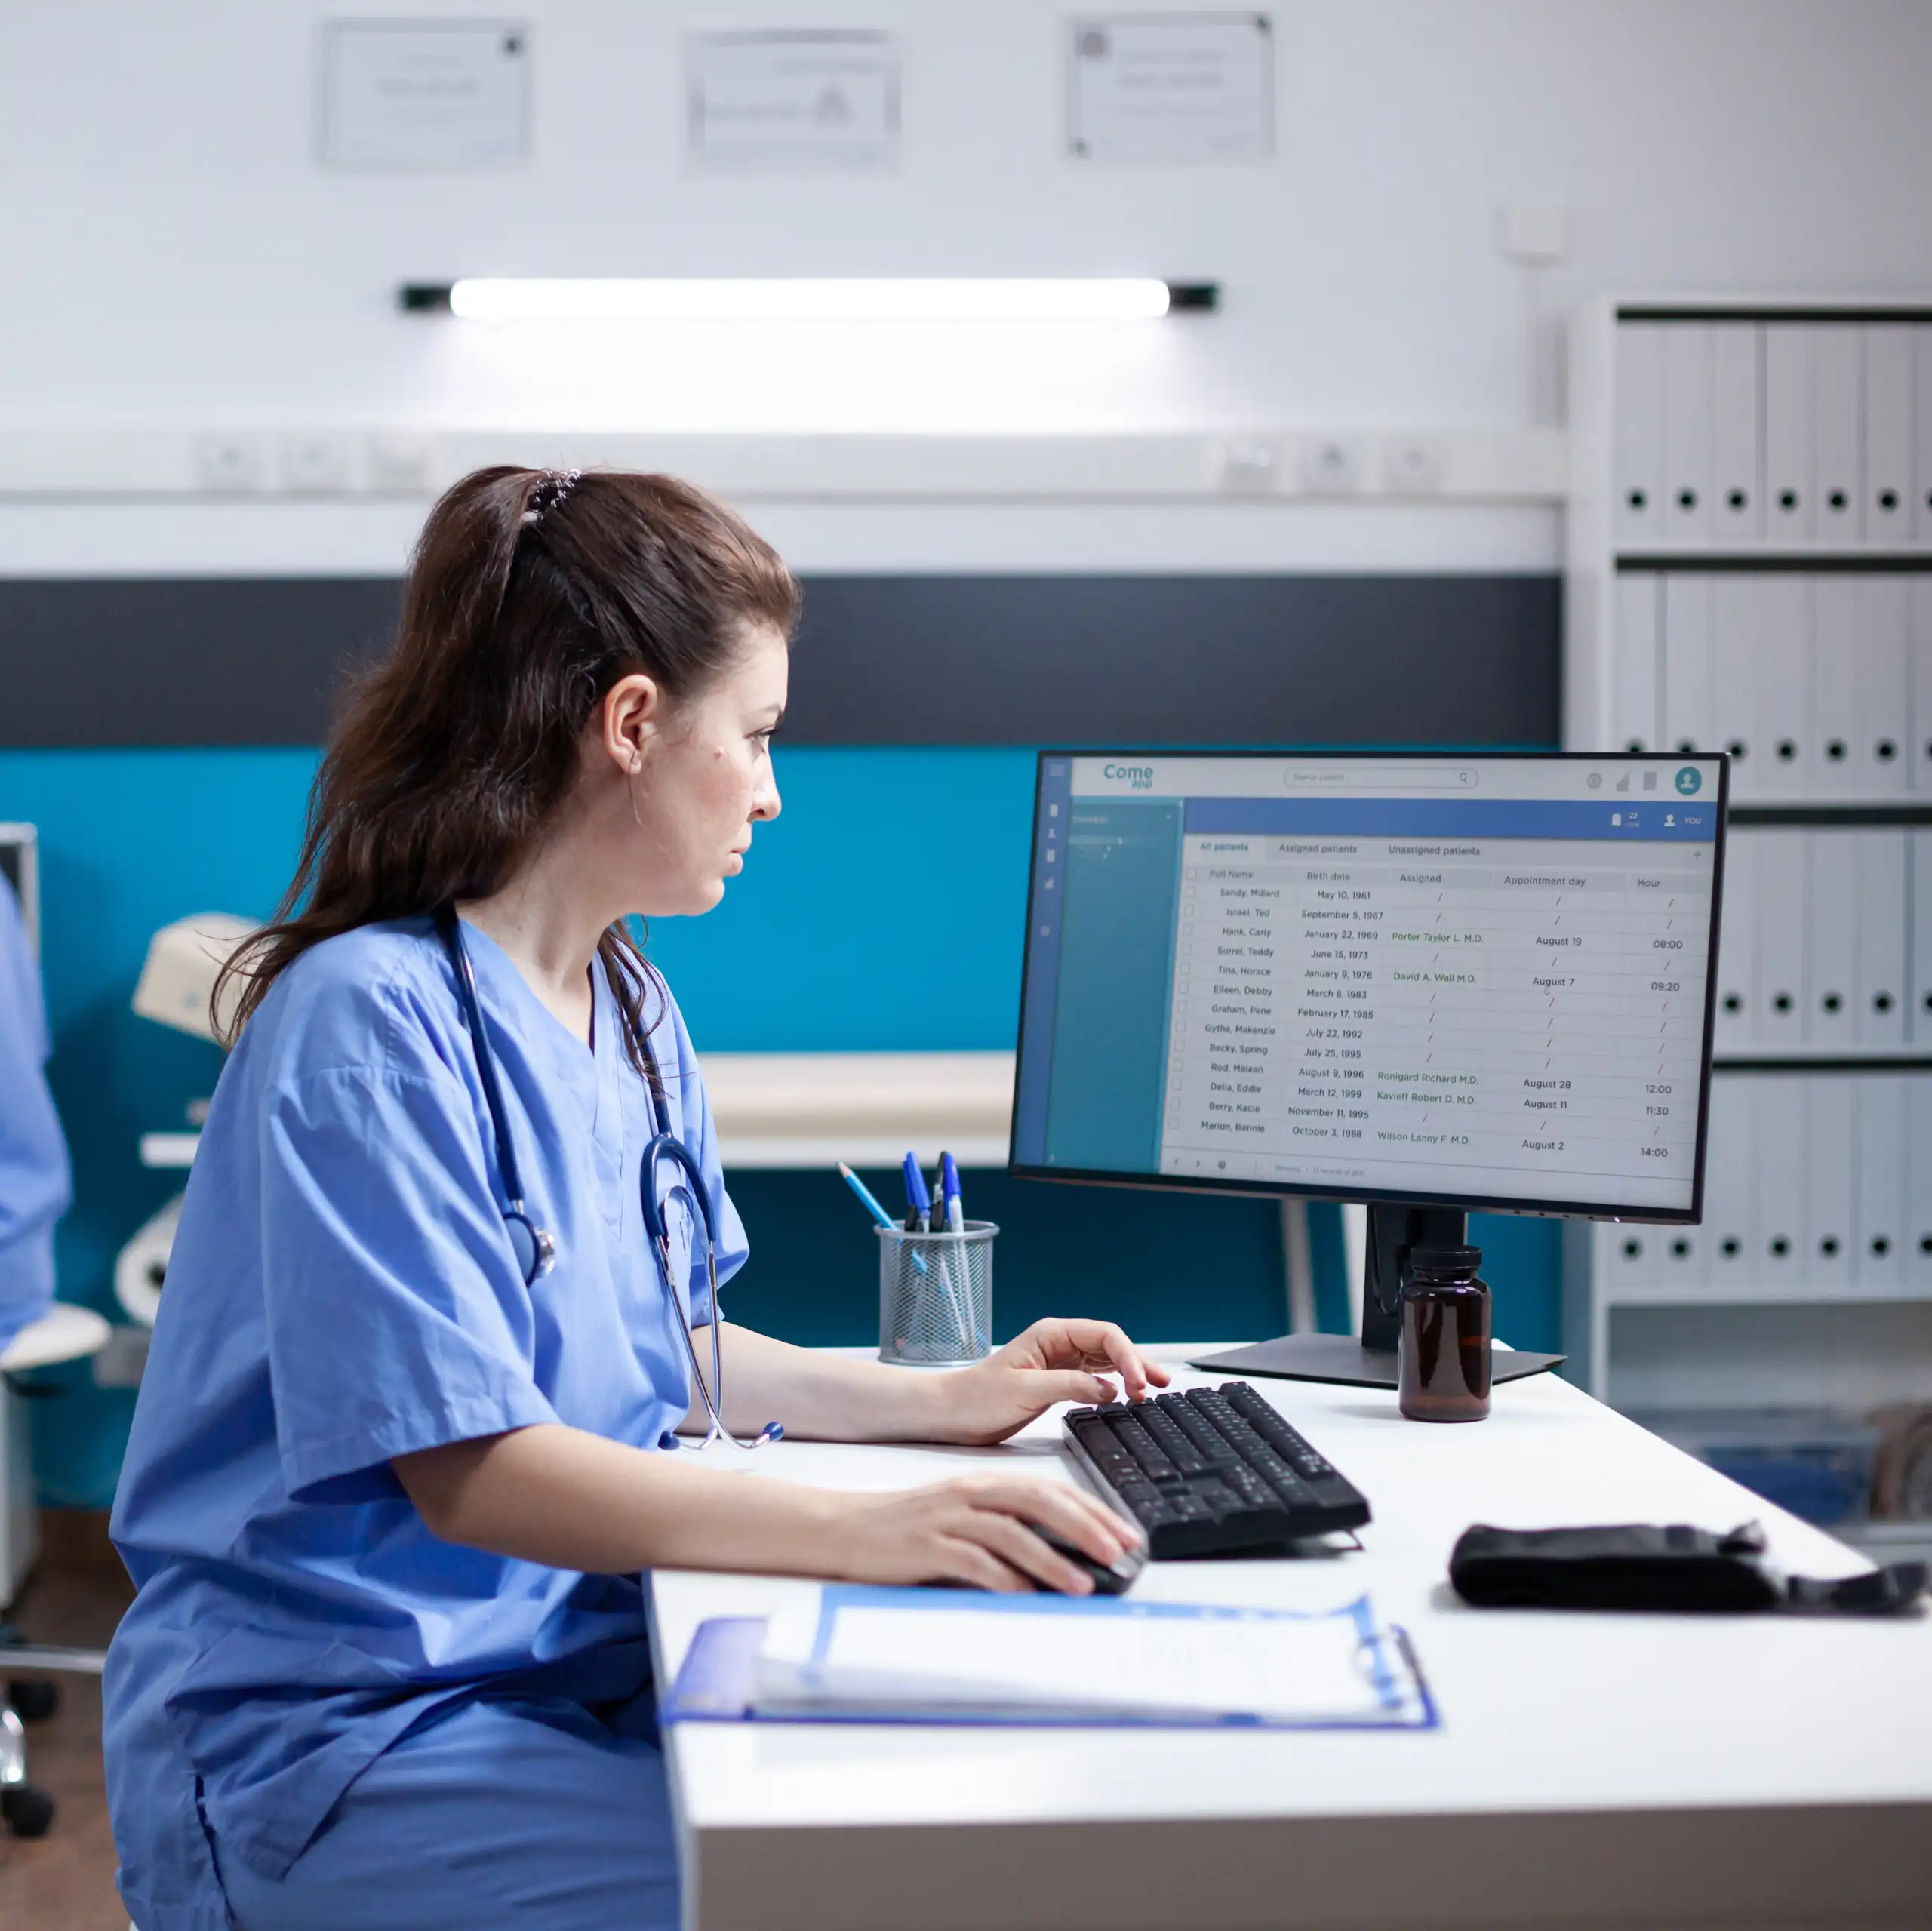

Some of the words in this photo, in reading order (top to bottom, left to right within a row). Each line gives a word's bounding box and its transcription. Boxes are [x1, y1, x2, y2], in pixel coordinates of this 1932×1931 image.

[1103, 764, 1153, 779] Come
[1131, 780, 1152, 789] app
[1214, 844, 1249, 852] patients
[1279, 844, 1318, 853] Assigned
[1321, 845, 1357, 853] patients
[1389, 845, 1441, 856] Unassigned
[1443, 847, 1480, 856] patients
[1210, 869, 1226, 878] Full
[1228, 870, 1254, 879] Name
[1330, 872, 1350, 881] date
[1400, 873, 1441, 884] Assigned
[1504, 876, 1566, 887] Appointment
[1569, 877, 1586, 888] day
[1638, 879, 1660, 888] Hour
[1220, 889, 1247, 899] Sandy,
[1251, 889, 1280, 898] Millard
[1317, 891, 1334, 901] May
[1338, 892, 1349, 900] 10,
[1301, 911, 1349, 921] September
[1352, 912, 1360, 921] 5,
[1364, 912, 1383, 920] 1967
[1223, 928, 1246, 936] Hank,
[1303, 930, 1339, 940] January
[1341, 931, 1355, 939] 22,
[1358, 931, 1378, 939] 1969
[1392, 932, 1420, 941] Porter
[1423, 933, 1450, 943] Taylor
[1453, 934, 1460, 942] L.
[1464, 934, 1484, 943] M.D.
[1535, 936, 1568, 946] August
[1572, 937, 1582, 946] 19
[1653, 939, 1683, 949] 08:00
[1217, 946, 1245, 956] Sorrel,
[1248, 947, 1274, 958] Teddy
[1311, 950, 1332, 958] June
[1335, 951, 1346, 959] 15,
[1349, 951, 1368, 959] 1973
[1219, 965, 1238, 976] Tina,
[1241, 967, 1271, 976] Horace
[1304, 970, 1339, 979] January
[1342, 970, 1349, 979] 9,
[1352, 971, 1373, 979] 1976
[1393, 972, 1420, 981] David
[1423, 973, 1432, 981] A.
[1435, 973, 1454, 982] Wall
[1457, 974, 1477, 983] M.D.
[1533, 977, 1565, 987] August
[1569, 978, 1575, 986] 7
[1214, 985, 1241, 995] Eileen,
[1244, 985, 1272, 997] Debby
[1651, 982, 1680, 991] 09:20
[1307, 989, 1333, 998] March
[1347, 990, 1367, 999] 1983
[1211, 1004, 1247, 1015] Graham,
[1297, 1008, 1337, 1019] February
[1340, 1010, 1351, 1019] 17,
[1354, 1010, 1374, 1019] 1985
[1205, 1024, 1232, 1034] Gytha,
[1235, 1025, 1275, 1035] Makenzie
[1305, 1029, 1324, 1039] July
[1326, 1029, 1340, 1038] 22,
[1343, 1030, 1363, 1039] 1992
[1210, 1043, 1237, 1054] Becky,
[1240, 1045, 1268, 1056] Spring
[1304, 1048, 1322, 1058] July
[1324, 1049, 1338, 1058] 25,
[1341, 1050, 1361, 1059] 1995
[1233, 1064, 1264, 1074] Maleah
[1299, 1067, 1330, 1078] August
[1333, 1069, 1341, 1079] 9,
[1343, 1070, 1364, 1078] 1996
[1378, 1072, 1419, 1082] Ronigard
[1422, 1074, 1456, 1084] Richard
[1460, 1075, 1478, 1084] M.D.
[1211, 1082, 1235, 1093] Delia,
[1237, 1084, 1262, 1093] Eddie
[1523, 1079, 1556, 1090] August
[1560, 1081, 1571, 1089] 28
[1645, 1084, 1672, 1094] 12:00
[1298, 1087, 1324, 1096] March
[1327, 1089, 1338, 1098] 12,
[1342, 1090, 1362, 1099] 1999
[1377, 1091, 1408, 1101] Kavieff
[1411, 1093, 1441, 1102] Robert
[1445, 1095, 1454, 1103] D.
[1457, 1096, 1477, 1105] M.D.
[1209, 1102, 1234, 1113] Berry,
[1237, 1103, 1260, 1113] Kacie
[1524, 1099, 1557, 1109] August
[1561, 1101, 1567, 1109] 11
[1288, 1107, 1334, 1118] November
[1337, 1109, 1346, 1118] 11,
[1349, 1110, 1369, 1119] 1995
[1646, 1106, 1669, 1115] 11:30
[1201, 1121, 1233, 1132] Marion,
[1235, 1122, 1265, 1133] Bennie
[1292, 1127, 1328, 1137] October
[1331, 1128, 1340, 1138] 3,
[1342, 1129, 1362, 1139] 1988
[1377, 1131, 1407, 1141] Wilson
[1411, 1133, 1438, 1144] Lanny
[1441, 1135, 1448, 1144] F.
[1451, 1136, 1470, 1145] M.D.
[1522, 1139, 1555, 1150] August
[1558, 1142, 1564, 1151] 2
[1641, 1148, 1668, 1158] 14:00
